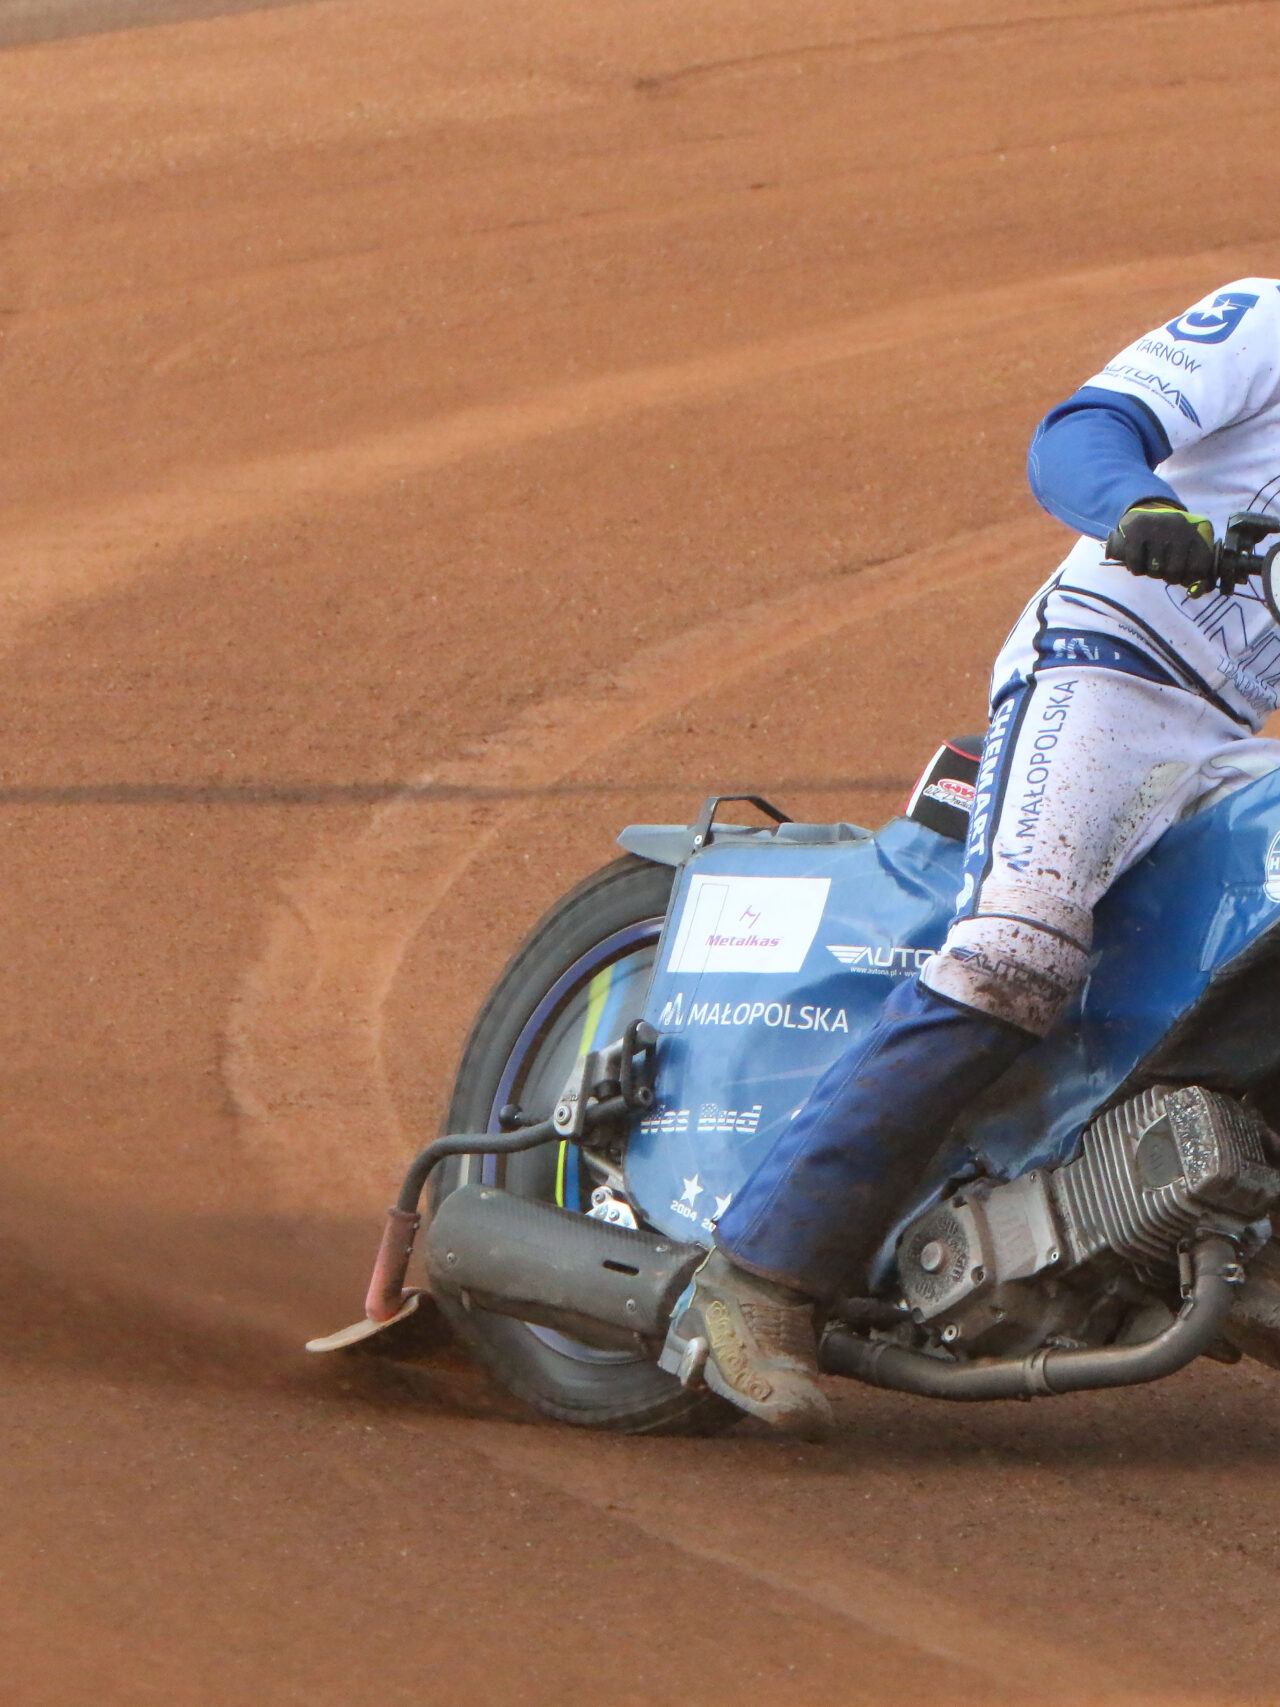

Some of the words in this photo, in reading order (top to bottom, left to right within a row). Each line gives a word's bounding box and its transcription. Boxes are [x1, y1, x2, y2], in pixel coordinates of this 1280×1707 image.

[1136, 339, 1202, 374] TARNÓW
[1105, 364, 1180, 406] UTONA
[1016, 680, 1079, 838] MAŁOPOLSKA
[705, 935, 782, 947] Metalkas
[688, 1002, 849, 1033] MAŁOPOLSKA
[670, 1200, 698, 1222] 2004
